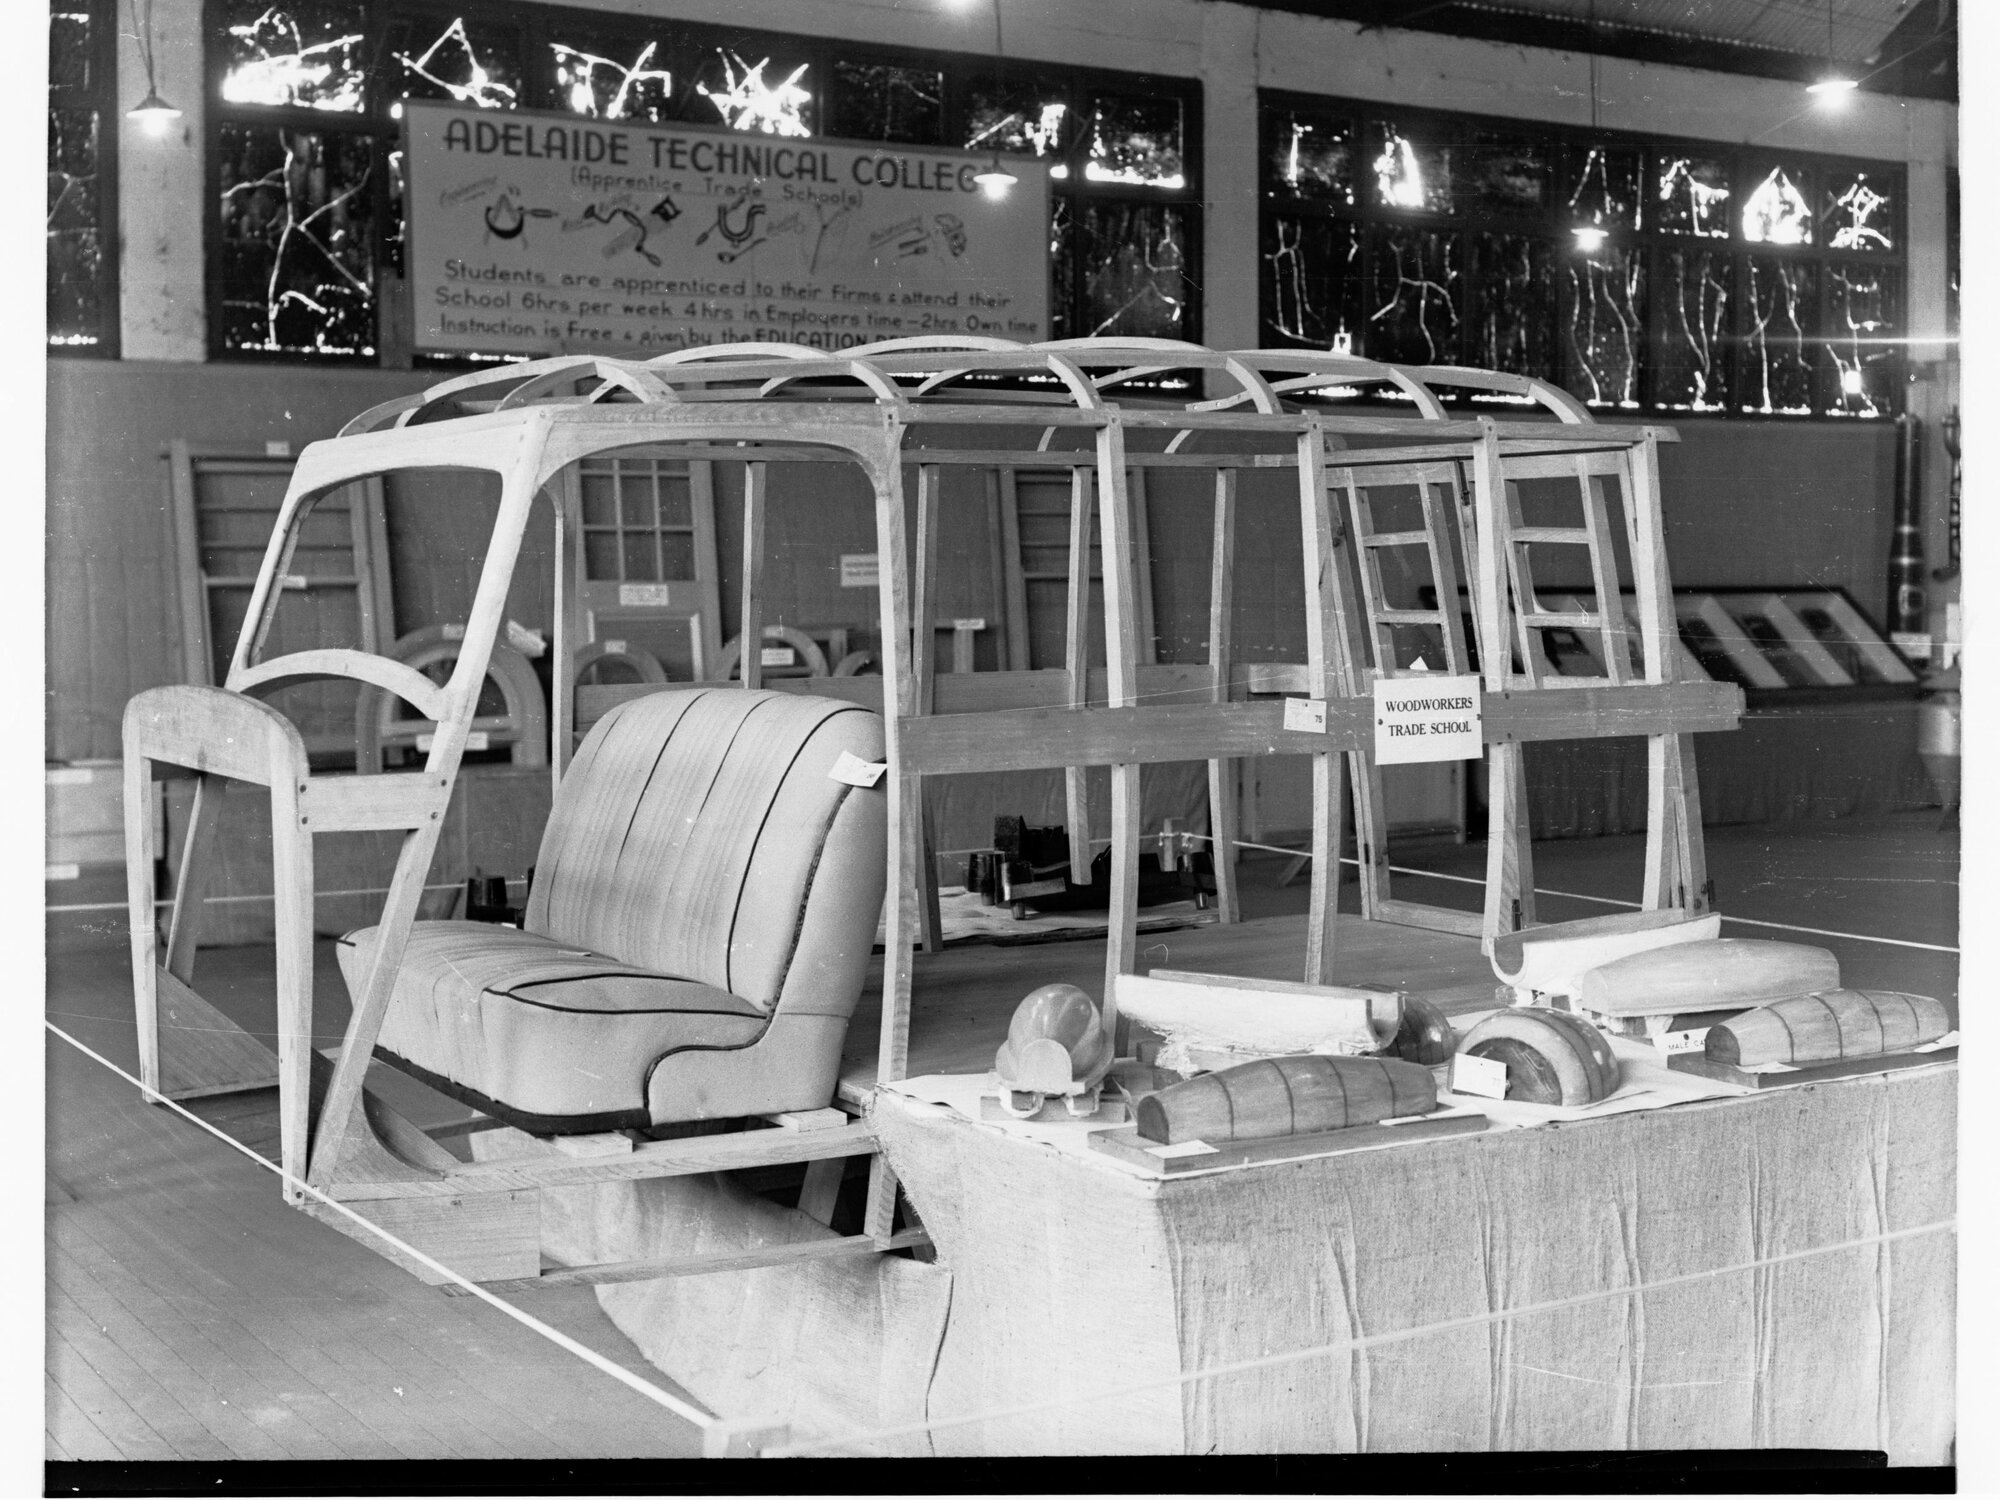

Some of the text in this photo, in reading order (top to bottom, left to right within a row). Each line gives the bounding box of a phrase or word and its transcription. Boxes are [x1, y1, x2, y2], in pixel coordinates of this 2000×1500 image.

[443, 117, 996, 194] ADELAIDE TECHNICAL COLLEG
[571, 165, 683, 193] (Apprentice
[704, 176, 763, 198] Trade
[444, 258, 547, 287] Students
[560, 273, 601, 288] are
[612, 275, 747, 297] apprenticed
[756, 281, 774, 298] to
[781, 281, 823, 301] their
[831, 283, 881, 303] Firms
[902, 290, 959, 307] attend
[968, 291, 1011, 308] their
[435, 285, 511, 309] School
[522, 291, 571, 313] 6hrs
[578, 300, 614, 319] per
[622, 300, 674, 317] week
[743, 303, 760, 321] in
[766, 304, 861, 330] Employers
[866, 310, 902, 328] time
[965, 313, 1003, 333] Own
[1007, 316, 1039, 333] time
[438, 312, 537, 337] Instruction
[543, 318, 561, 339] is
[567, 320, 613, 341] Free
[639, 324, 687, 348] given
[688, 326, 713, 346] by
[721, 327, 752, 344] the
[755, 328, 869, 349] EDUCATION
[1385, 696, 1473, 713] WOODWORKERS
[1388, 720, 1472, 737] TRADE SCHOOL
